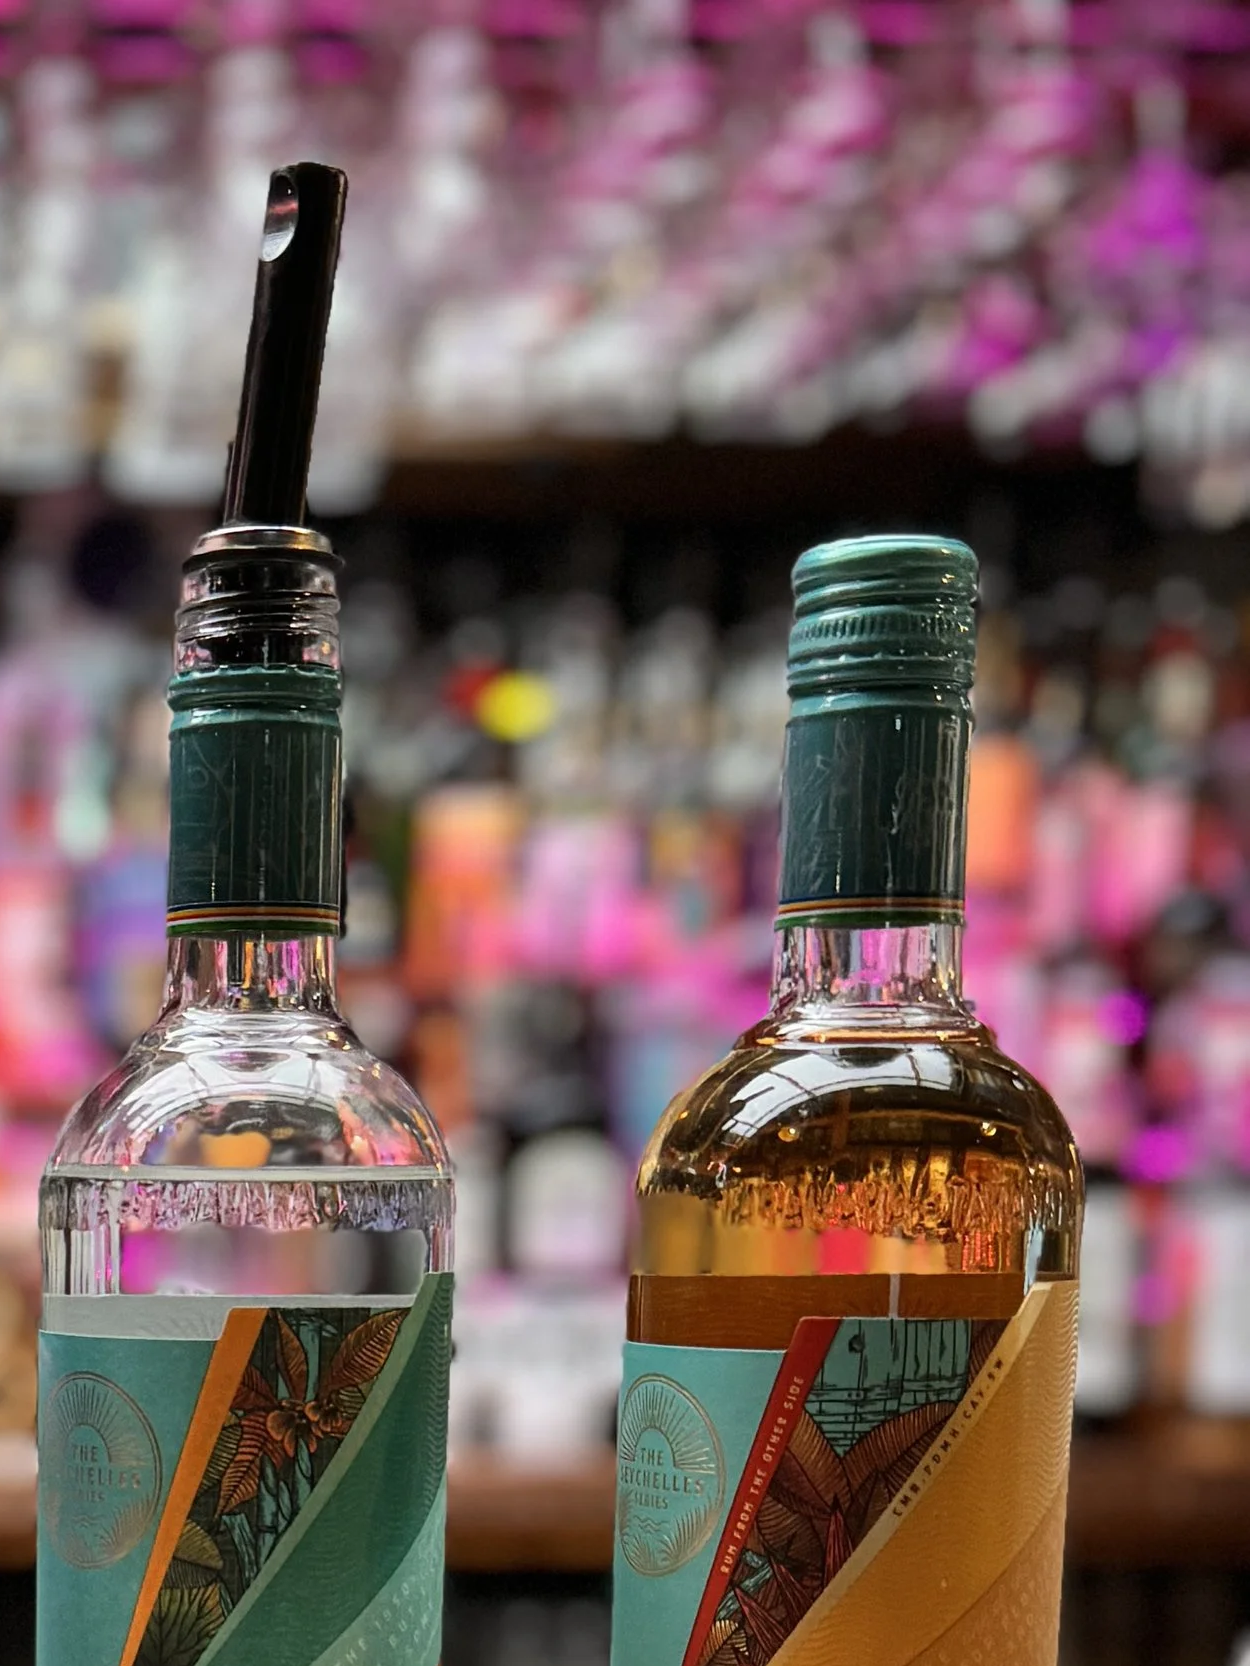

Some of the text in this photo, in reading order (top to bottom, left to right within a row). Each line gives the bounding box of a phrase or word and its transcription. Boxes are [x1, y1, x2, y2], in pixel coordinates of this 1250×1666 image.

[640, 1447, 664, 1466] THE
[720, 1375, 804, 1574] RUM FROM THE OTHER SIDE
